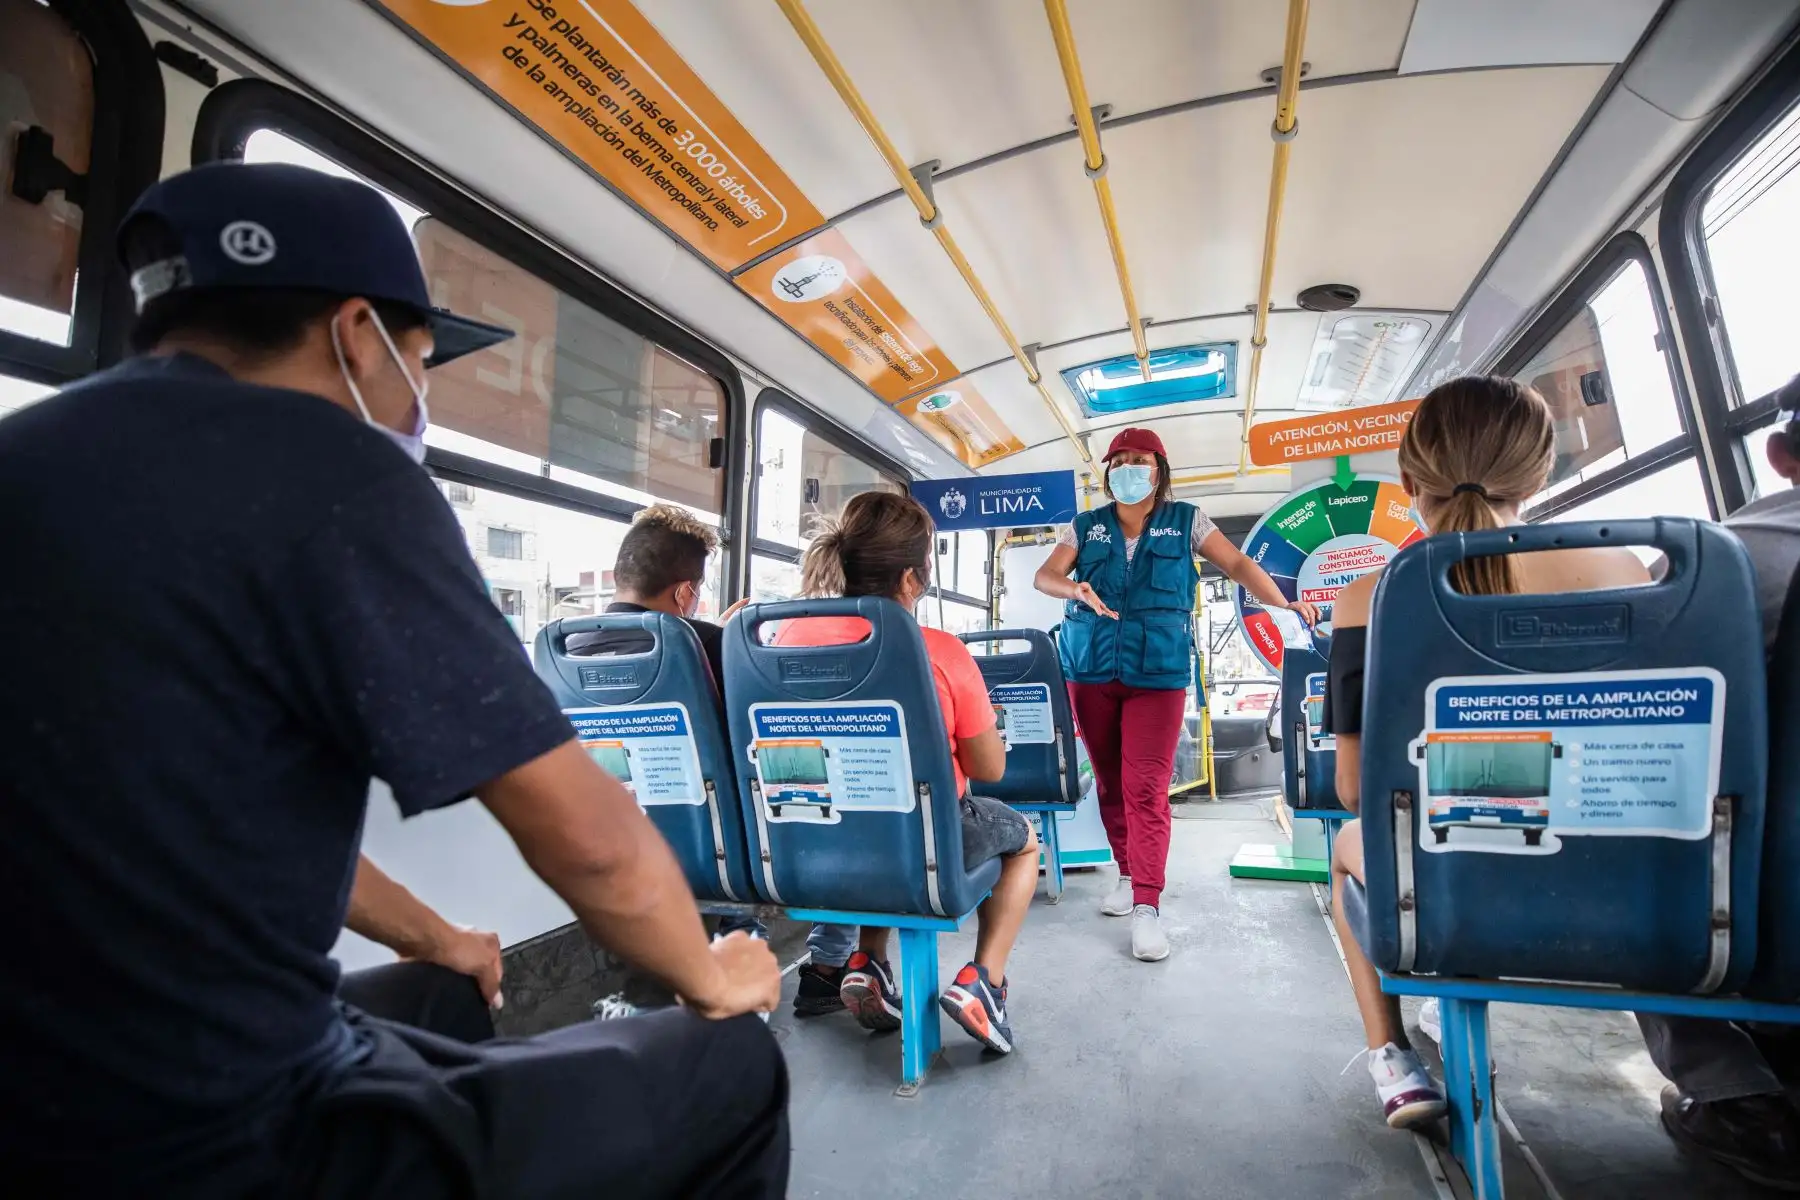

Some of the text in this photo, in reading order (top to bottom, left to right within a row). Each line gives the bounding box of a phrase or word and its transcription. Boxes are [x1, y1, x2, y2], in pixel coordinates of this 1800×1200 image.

[503, 12, 749, 229] y palmeras en la berma central y lateral
[549, 18, 631, 91] plantarán
[626, 88, 661, 120] más
[656, 116, 678, 136] de
[673, 129, 727, 178] 3,000
[718, 176, 767, 220] árboles
[502, 46, 718, 232] de la ampliación del Metropolitano.
[1269, 421, 1352, 446] ¡ATENCIÓN,
[1284, 430, 1401, 458] DE LIMA NORTE!
[980, 487, 1032, 497] MUNICIPALIDAD
[980, 494, 1044, 515] LIMA
[1328, 495, 1369, 507] Lapicero
[1277, 500, 1317, 529] Intenta de
[1288, 510, 1315, 532] nuevo
[1085, 530, 1112, 544] IMA
[1327, 548, 1374, 561] INICIAMOS
[1318, 554, 1386, 571] CONSTRUCCIÓN
[1323, 577, 1339, 586] UN
[1255, 622, 1278, 655] Lapicero
[1448, 688, 1698, 708] BENEFICIOS DE LA AMPLIACIÓN
[610, 718, 621, 726] DE
[621, 717, 632, 725] LA
[632, 714, 678, 724] AMPLIACIÓN
[762, 712, 891, 724] BENEFICIOS DE LA AMPLIACIÓN
[1458, 705, 1685, 722] NORTE DEL METROPOLITANO
[578, 724, 676, 736] NORTE DEL METROPOLITANO
[769, 724, 887, 733] NORTE DEL METROPOLITANO
[1583, 742, 1684, 751] Más cerca de casa
[1582, 758, 1599, 767] Un
[1635, 758, 1672, 766] nuevo
[1581, 775, 1668, 785] Un servicio para
[1580, 786, 1611, 795] todos
[1580, 799, 1678, 809] Ahorro de tiempo
[1588, 810, 1623, 818] dinero
